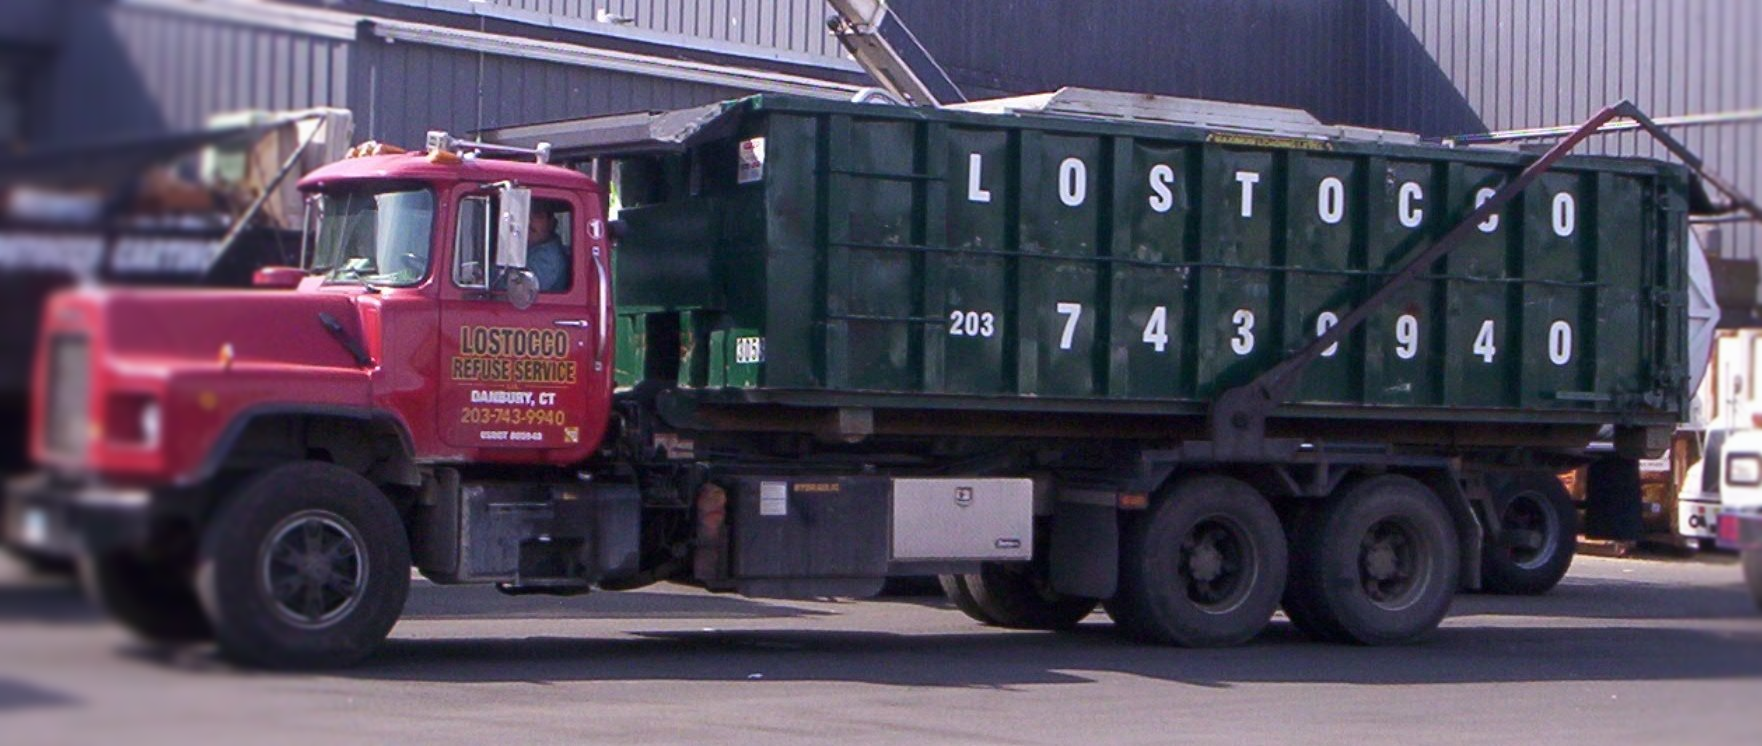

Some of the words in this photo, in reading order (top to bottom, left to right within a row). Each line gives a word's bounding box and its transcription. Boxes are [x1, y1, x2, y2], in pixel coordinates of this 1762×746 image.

[967, 152, 1576, 238] LOSTOCCO
[950, 310, 994, 337] 203
[461, 326, 569, 357] LOSTOCCO
[452, 356, 511, 382] REFUSE
[513, 359, 576, 384] SERVICE
[538, 392, 556, 406] CT
[461, 407, 565, 425] 203-743-9940
